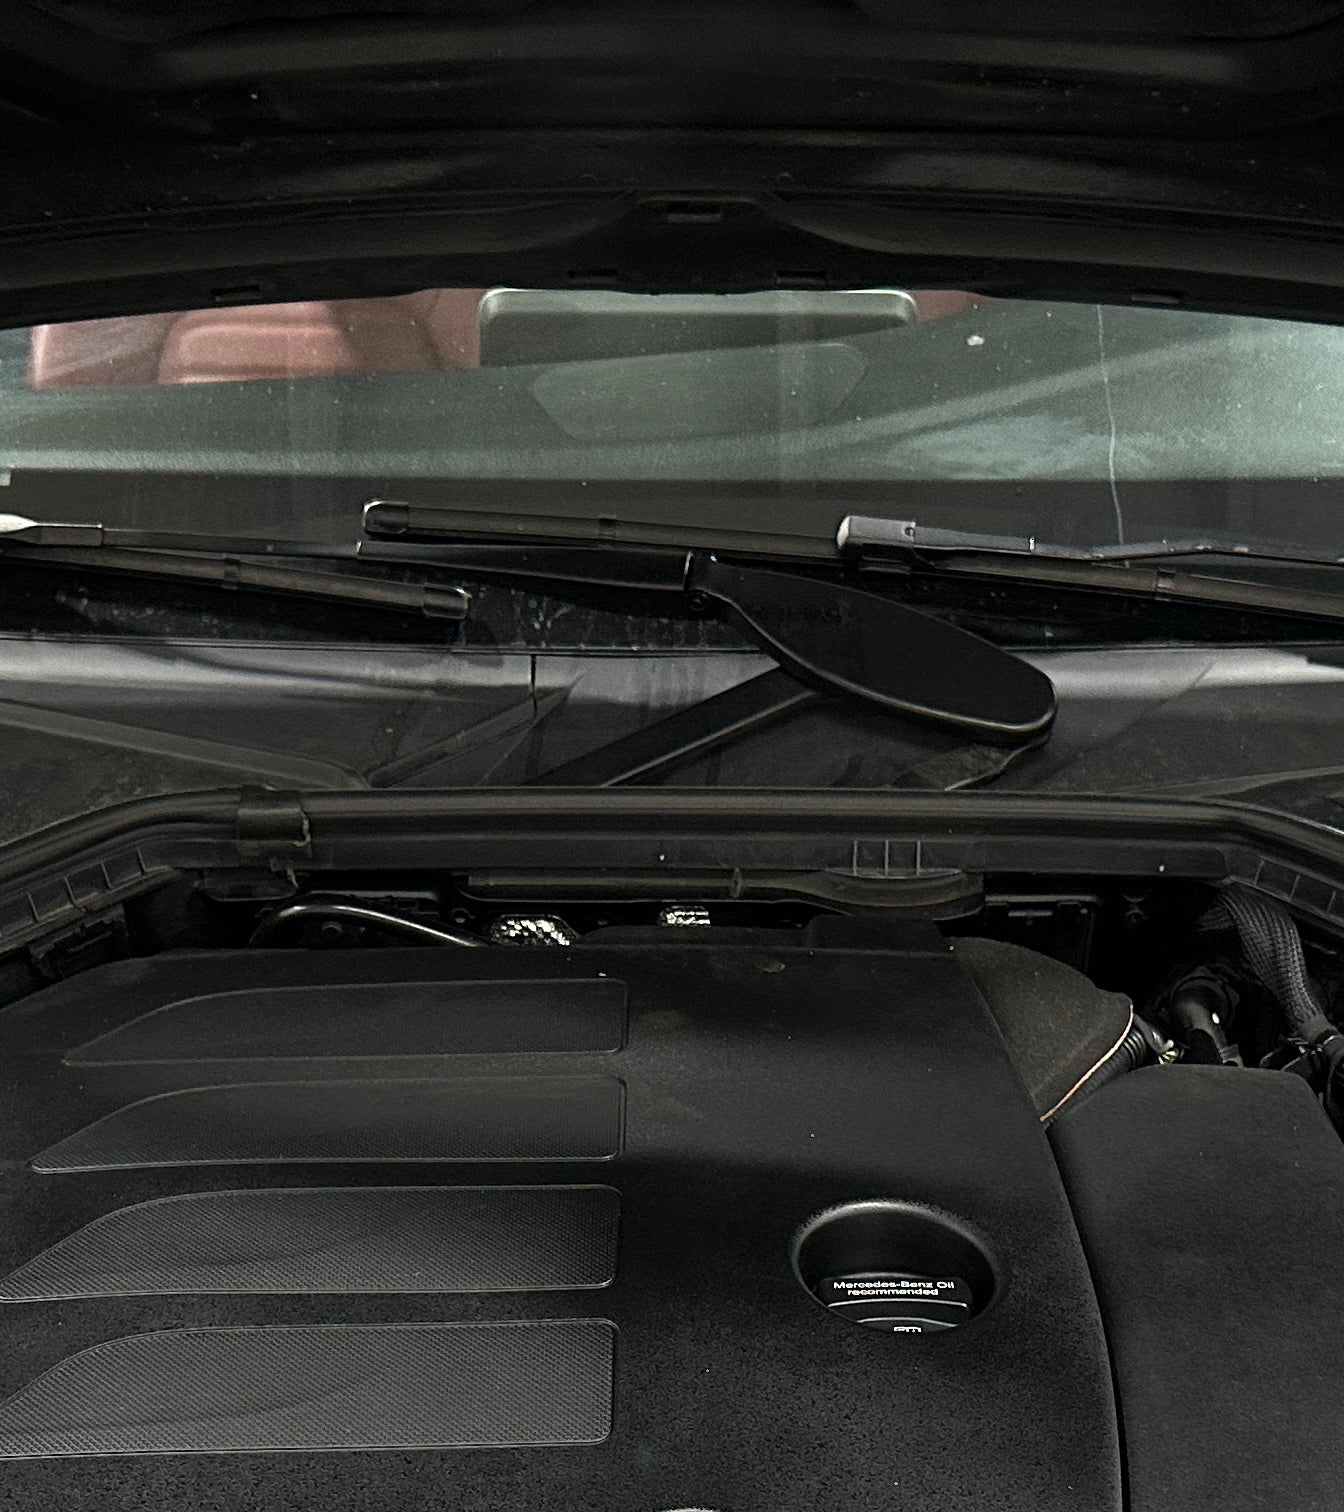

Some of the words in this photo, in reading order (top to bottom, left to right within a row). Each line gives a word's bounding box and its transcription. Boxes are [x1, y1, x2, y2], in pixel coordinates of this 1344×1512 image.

[833, 1280, 933, 1289] Mercedes-Benz
[937, 1280, 955, 1289] Oil
[847, 1288, 939, 1297] recommended
